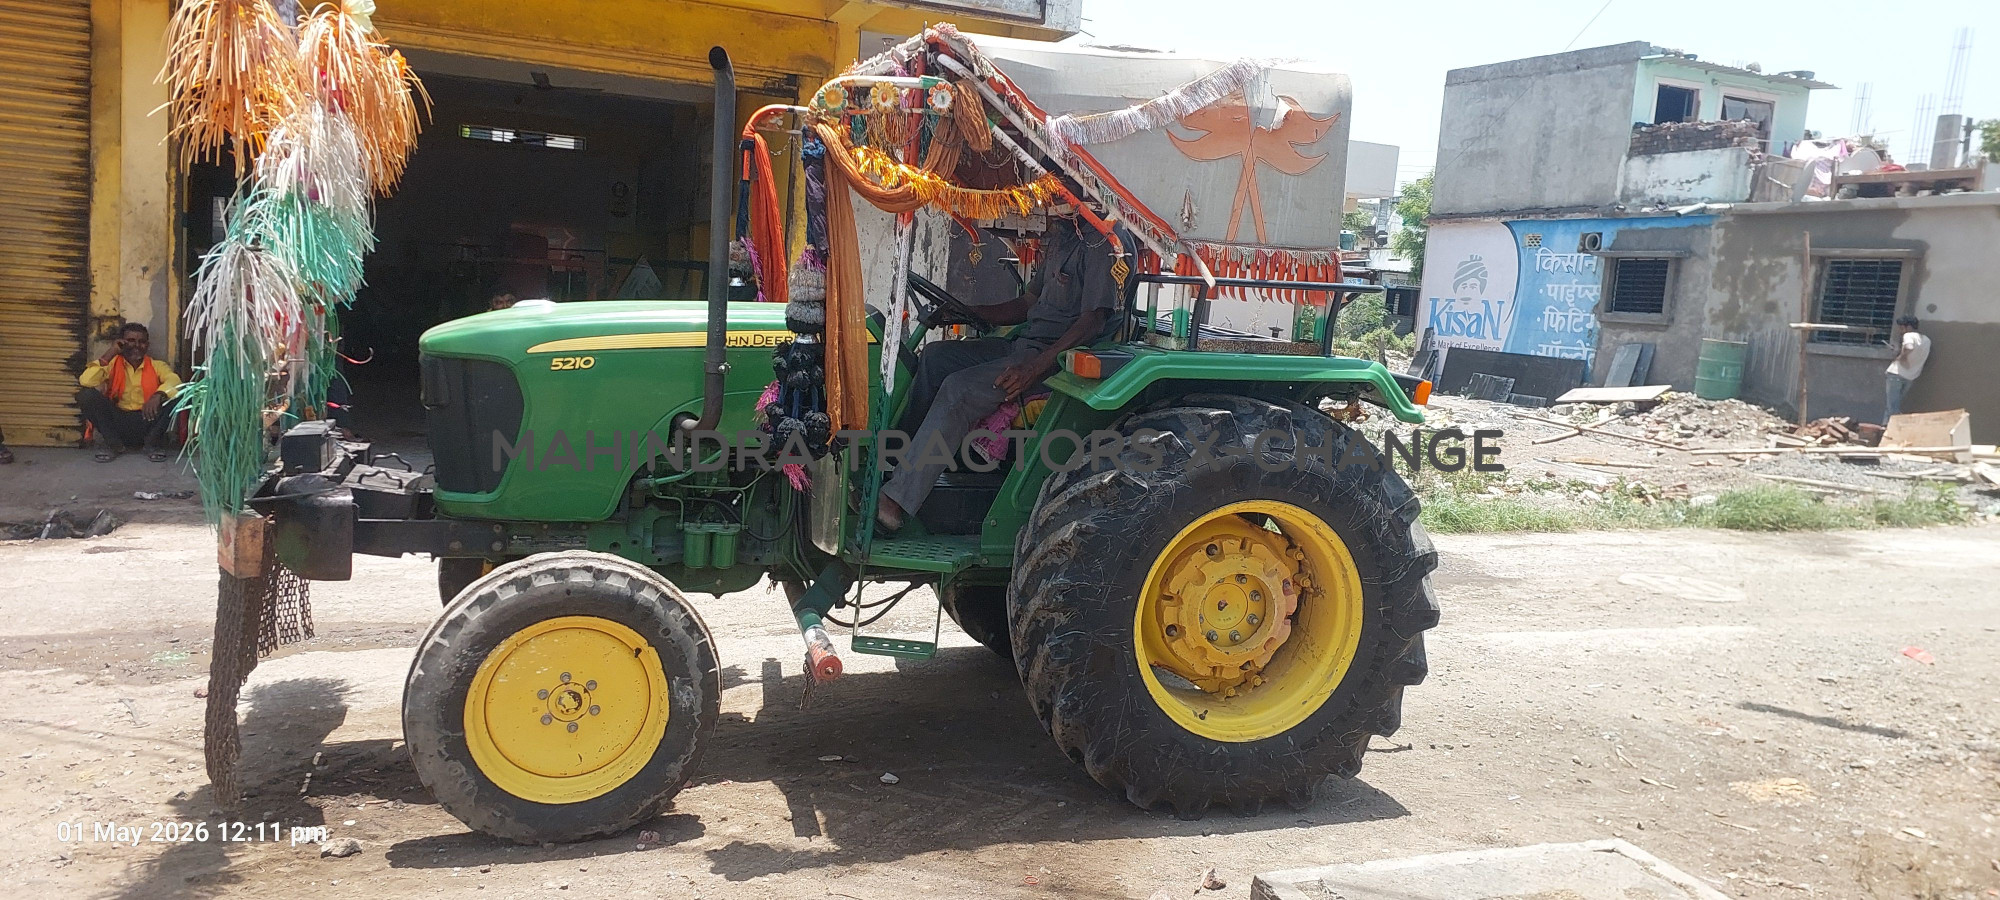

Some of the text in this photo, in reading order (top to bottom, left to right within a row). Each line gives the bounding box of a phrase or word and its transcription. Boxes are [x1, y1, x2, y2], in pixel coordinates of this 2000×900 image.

[1535, 247, 1598, 275] किसान
[753, 334, 795, 346] DEER
[550, 355, 596, 371] 5210
